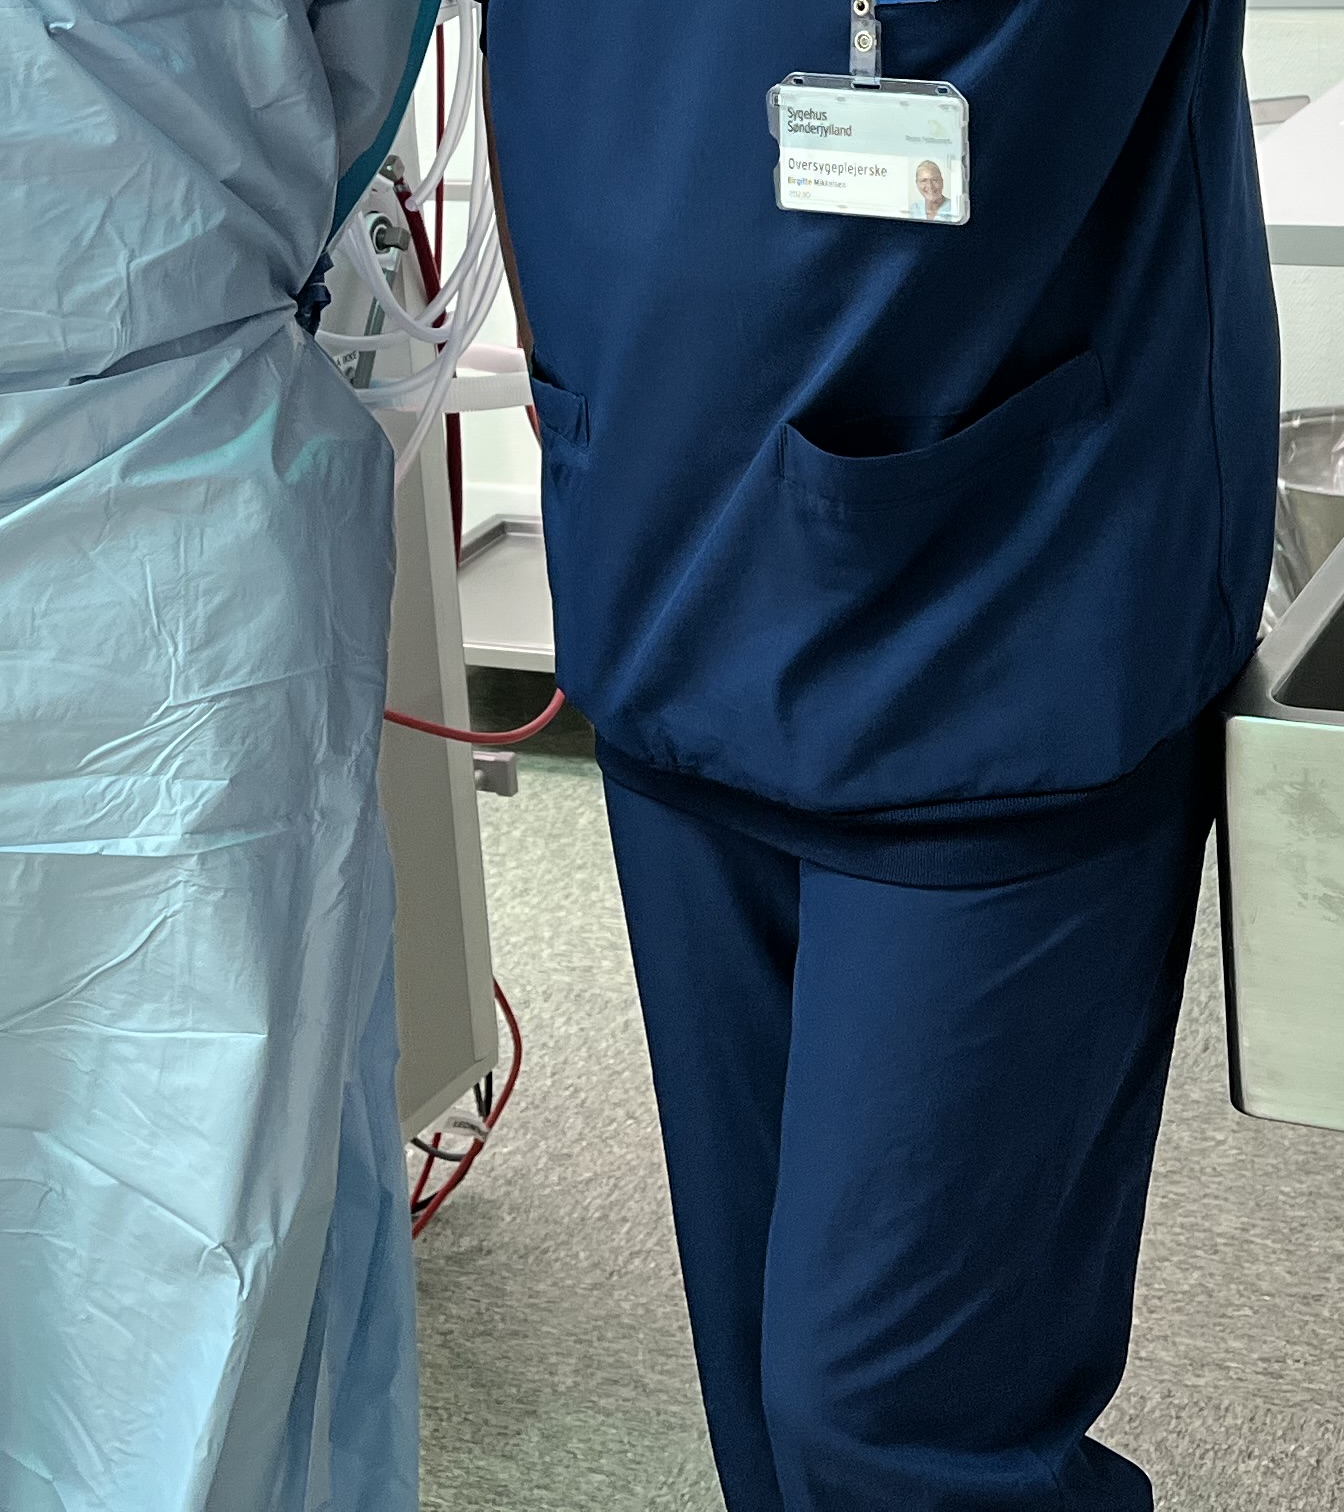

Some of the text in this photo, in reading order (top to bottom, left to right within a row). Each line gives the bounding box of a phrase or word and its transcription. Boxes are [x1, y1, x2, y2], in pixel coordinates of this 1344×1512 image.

[787, 106, 828, 121] Sygehus
[787, 120, 853, 138] Sønderjylland
[788, 157, 889, 178] Oversygeplejerske
